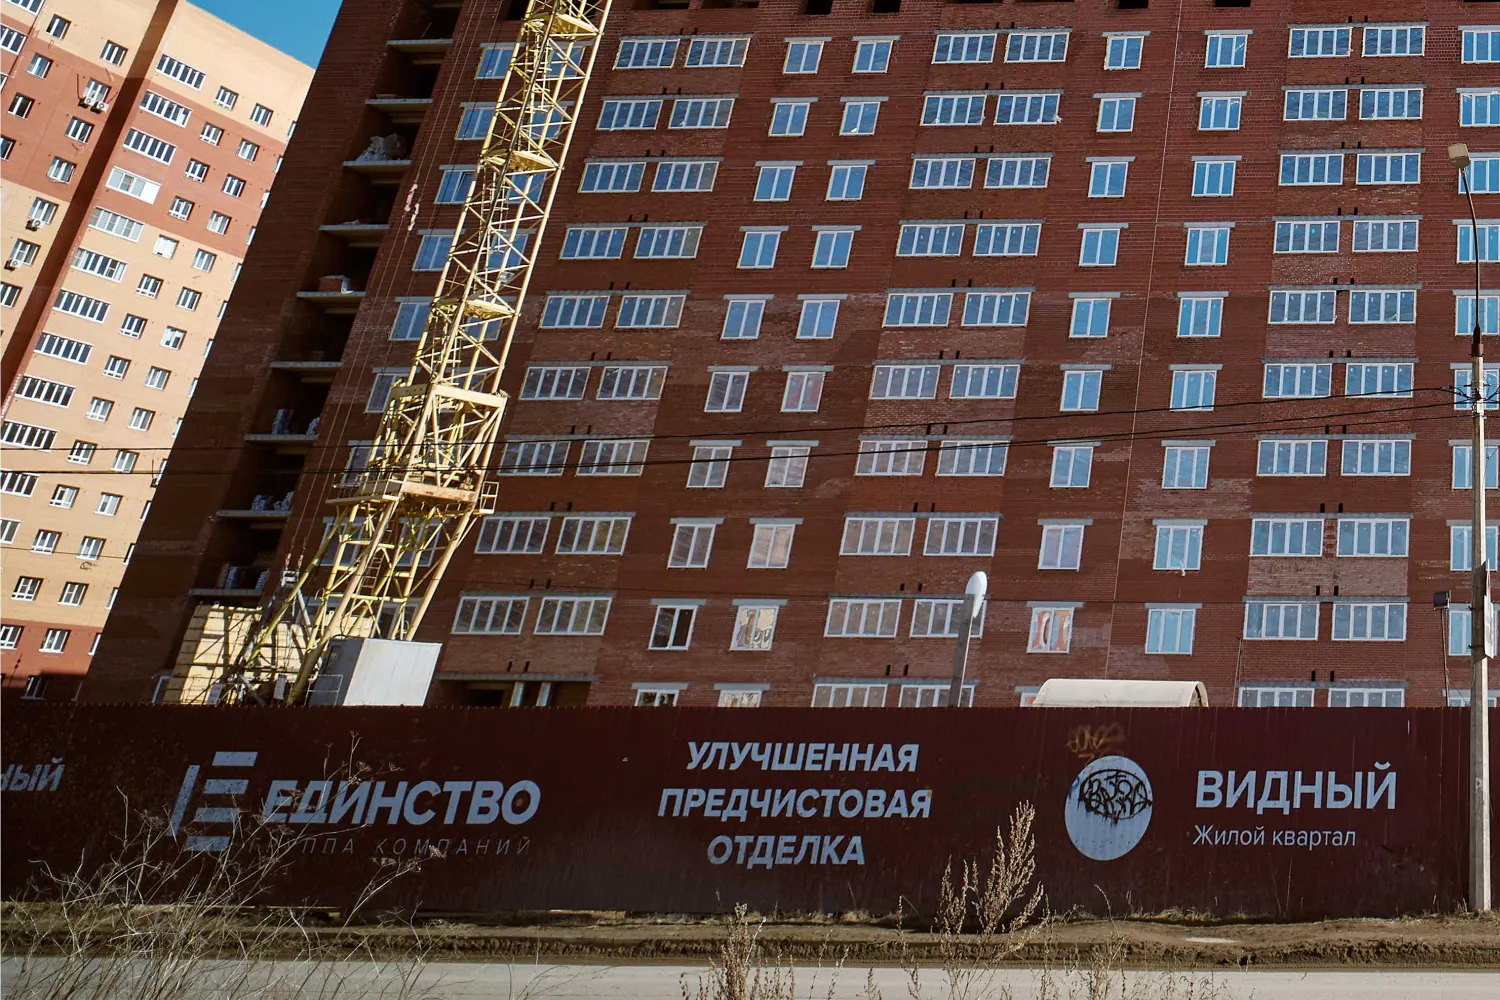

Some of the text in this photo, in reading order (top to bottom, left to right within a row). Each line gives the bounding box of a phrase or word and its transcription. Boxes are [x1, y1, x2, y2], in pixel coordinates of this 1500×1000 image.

[687, 741, 919, 772] УЛУЧШЕННАЯ
[265, 780, 541, 825] ЕДИНСТВО
[1195, 762, 1397, 815] ВИДНЫЙ
[657, 789, 932, 822] ПРЕДЧИСТОВАЯ
[375, 836, 531, 855] КОМПАНИЙ
[707, 836, 865, 869] ОТДЕЛКА
[1193, 825, 1356, 850] Жилой квартал
